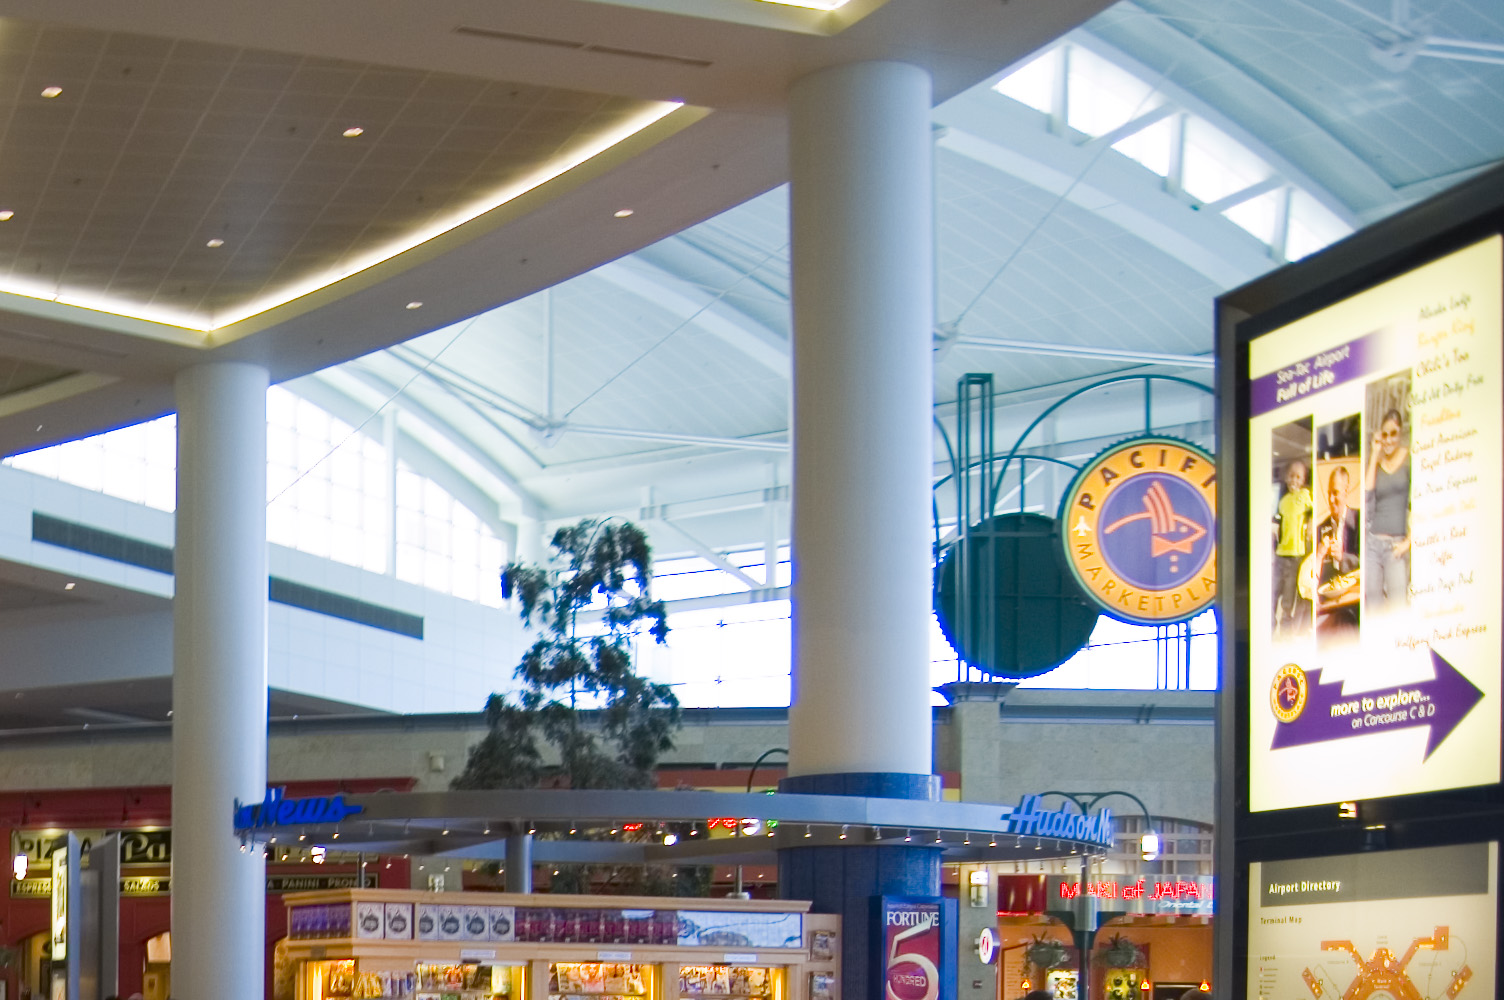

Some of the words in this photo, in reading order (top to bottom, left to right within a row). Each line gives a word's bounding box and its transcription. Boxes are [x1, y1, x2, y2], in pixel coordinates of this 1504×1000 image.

[1276, 362, 1311, 385] Sea-Tac
[1313, 345, 1350, 370] Airport
[1276, 382, 1297, 404] Full
[1298, 377, 1312, 395] of
[1312, 369, 1335, 390] Life
[1078, 449, 1216, 511] PACIFI
[1077, 543, 1216, 612] MARKETPLA
[1331, 700, 1360, 718] more
[1361, 695, 1374, 712] to
[1351, 716, 1363, 730] on
[1364, 708, 1408, 727] Concourse
[1409, 704, 1417, 719] C
[1418, 703, 1426, 718] &
[1427, 702, 1436, 717] D
[259, 787, 364, 827] News
[1000, 794, 1099, 845] Hudson
[281, 878, 320, 889] PANINI
[1122, 878, 1146, 900] of
[1268, 883, 1299, 896] Airport
[1301, 880, 1341, 892] Directory
[886, 911, 940, 926] FORTUNE
[1260, 916, 1287, 925] Terminal
[1289, 916, 1302, 924] Map
